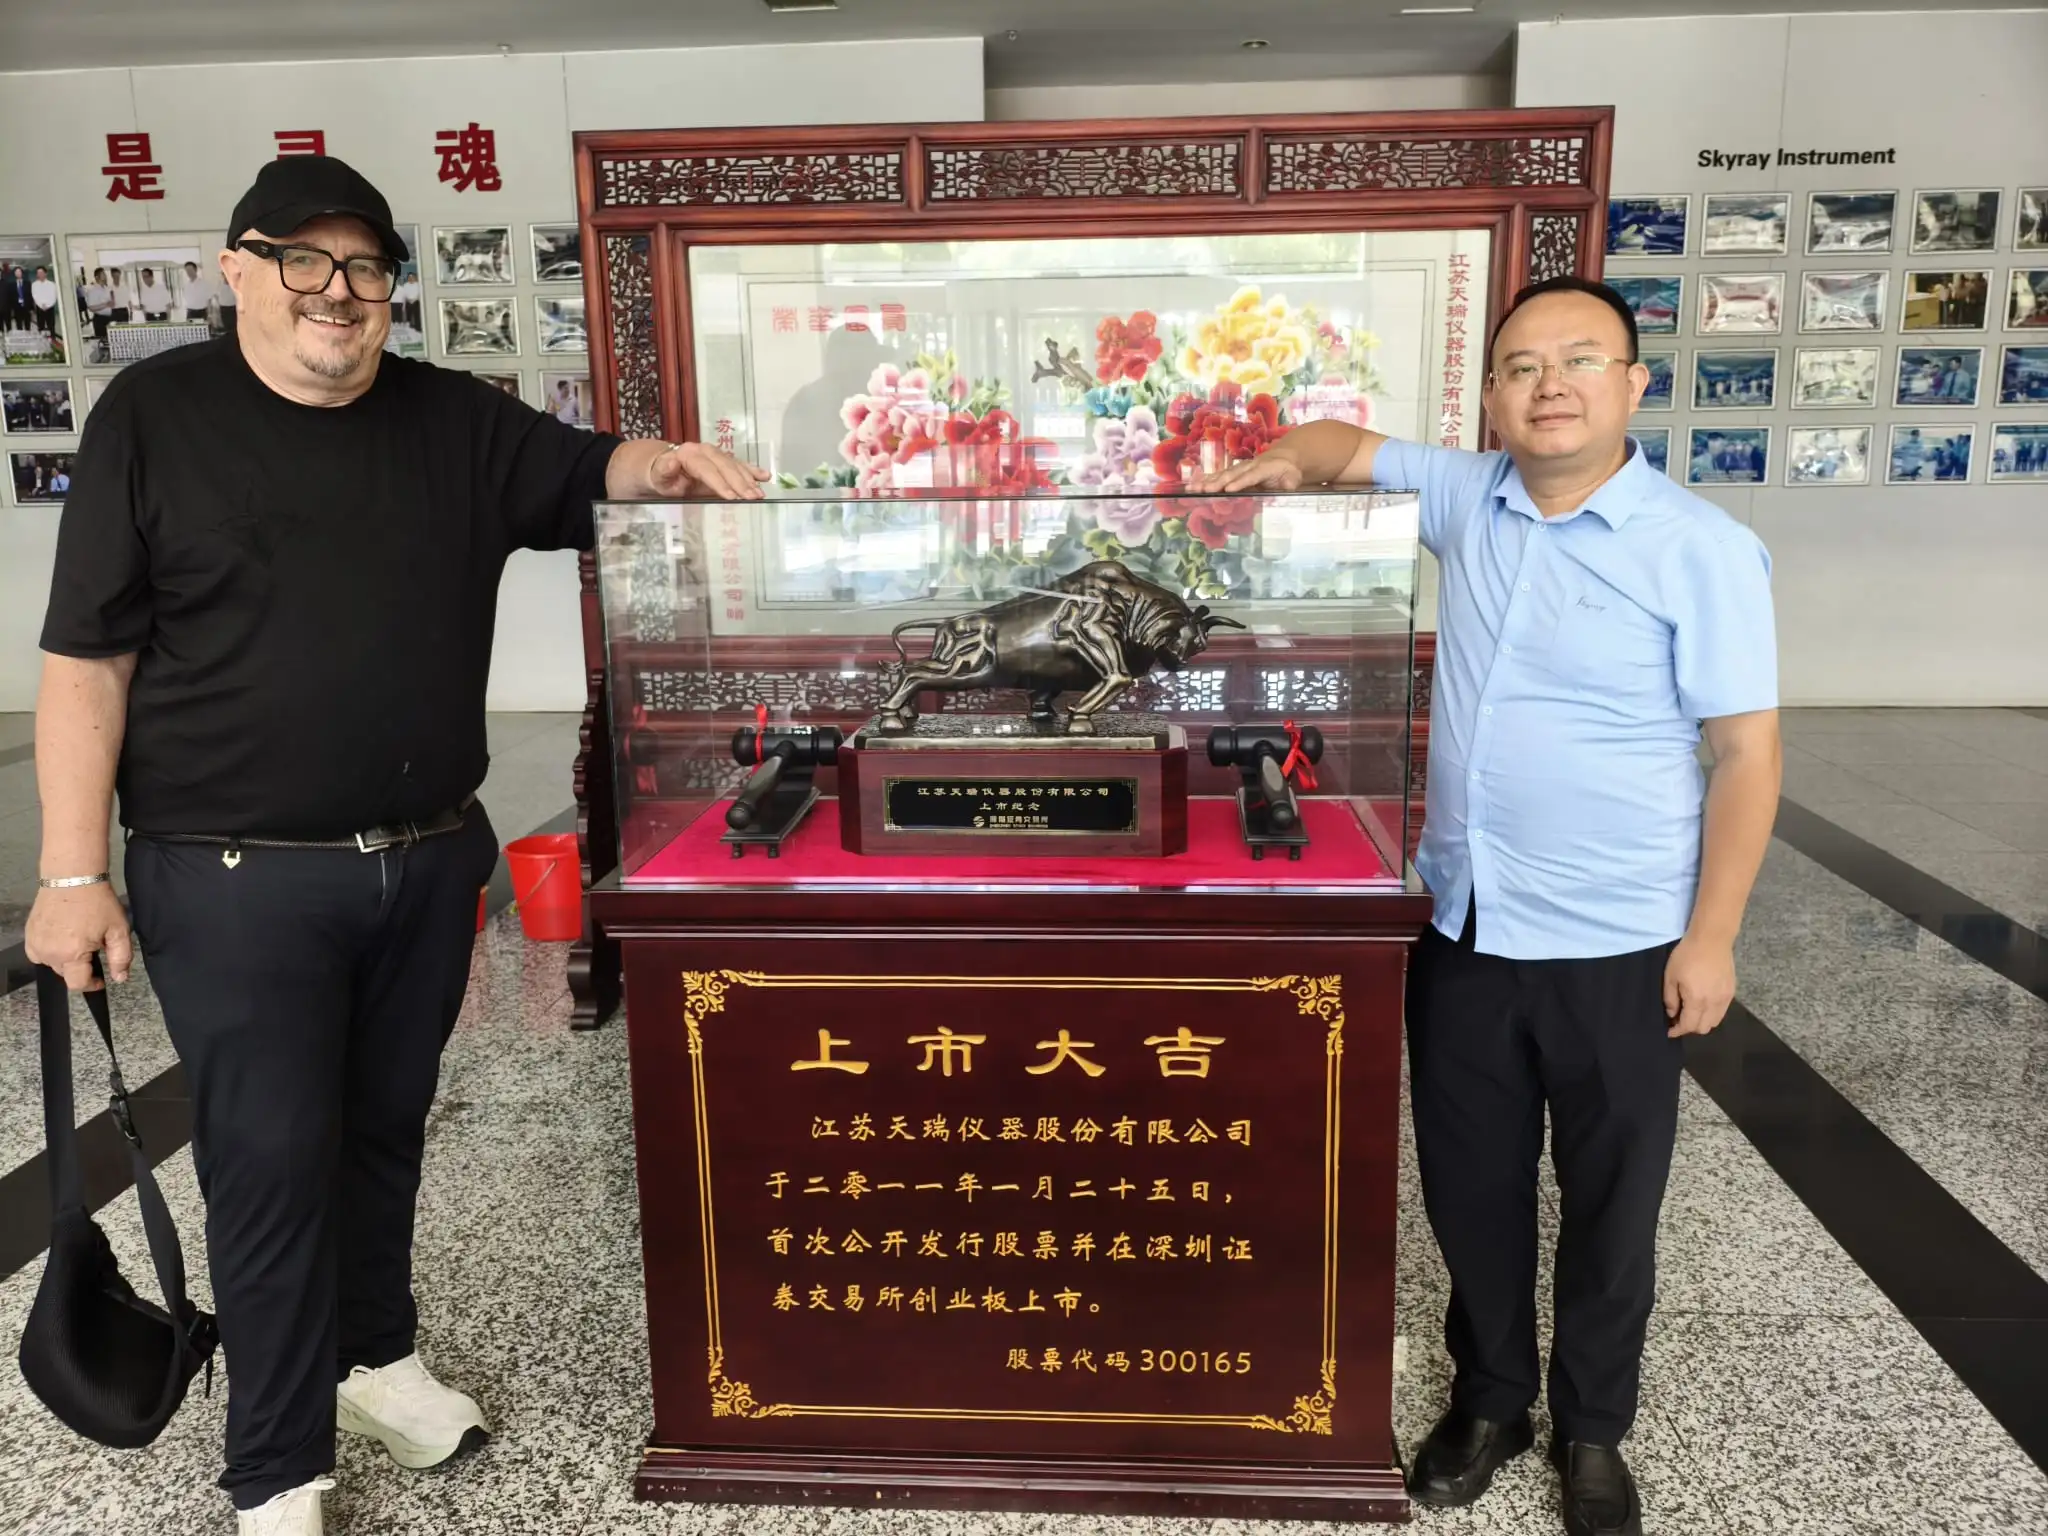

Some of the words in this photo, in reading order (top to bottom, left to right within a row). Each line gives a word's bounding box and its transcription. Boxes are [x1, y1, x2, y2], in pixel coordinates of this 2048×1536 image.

[1698, 149, 1771, 171] Skyray
[1777, 147, 1896, 166] Instrument
[1440, 253, 1471, 448] 江苏天瑞仪器股份有限公司
[790, 1025, 1226, 1079] 上市大吉
[811, 1113, 1252, 1147] 江苏天瑞仪器股份有限公司
[767, 1226, 1254, 1263] 首次公开发行股票并在深圳证
[772, 1283, 1100, 1316] 券交易所创业板上市。
